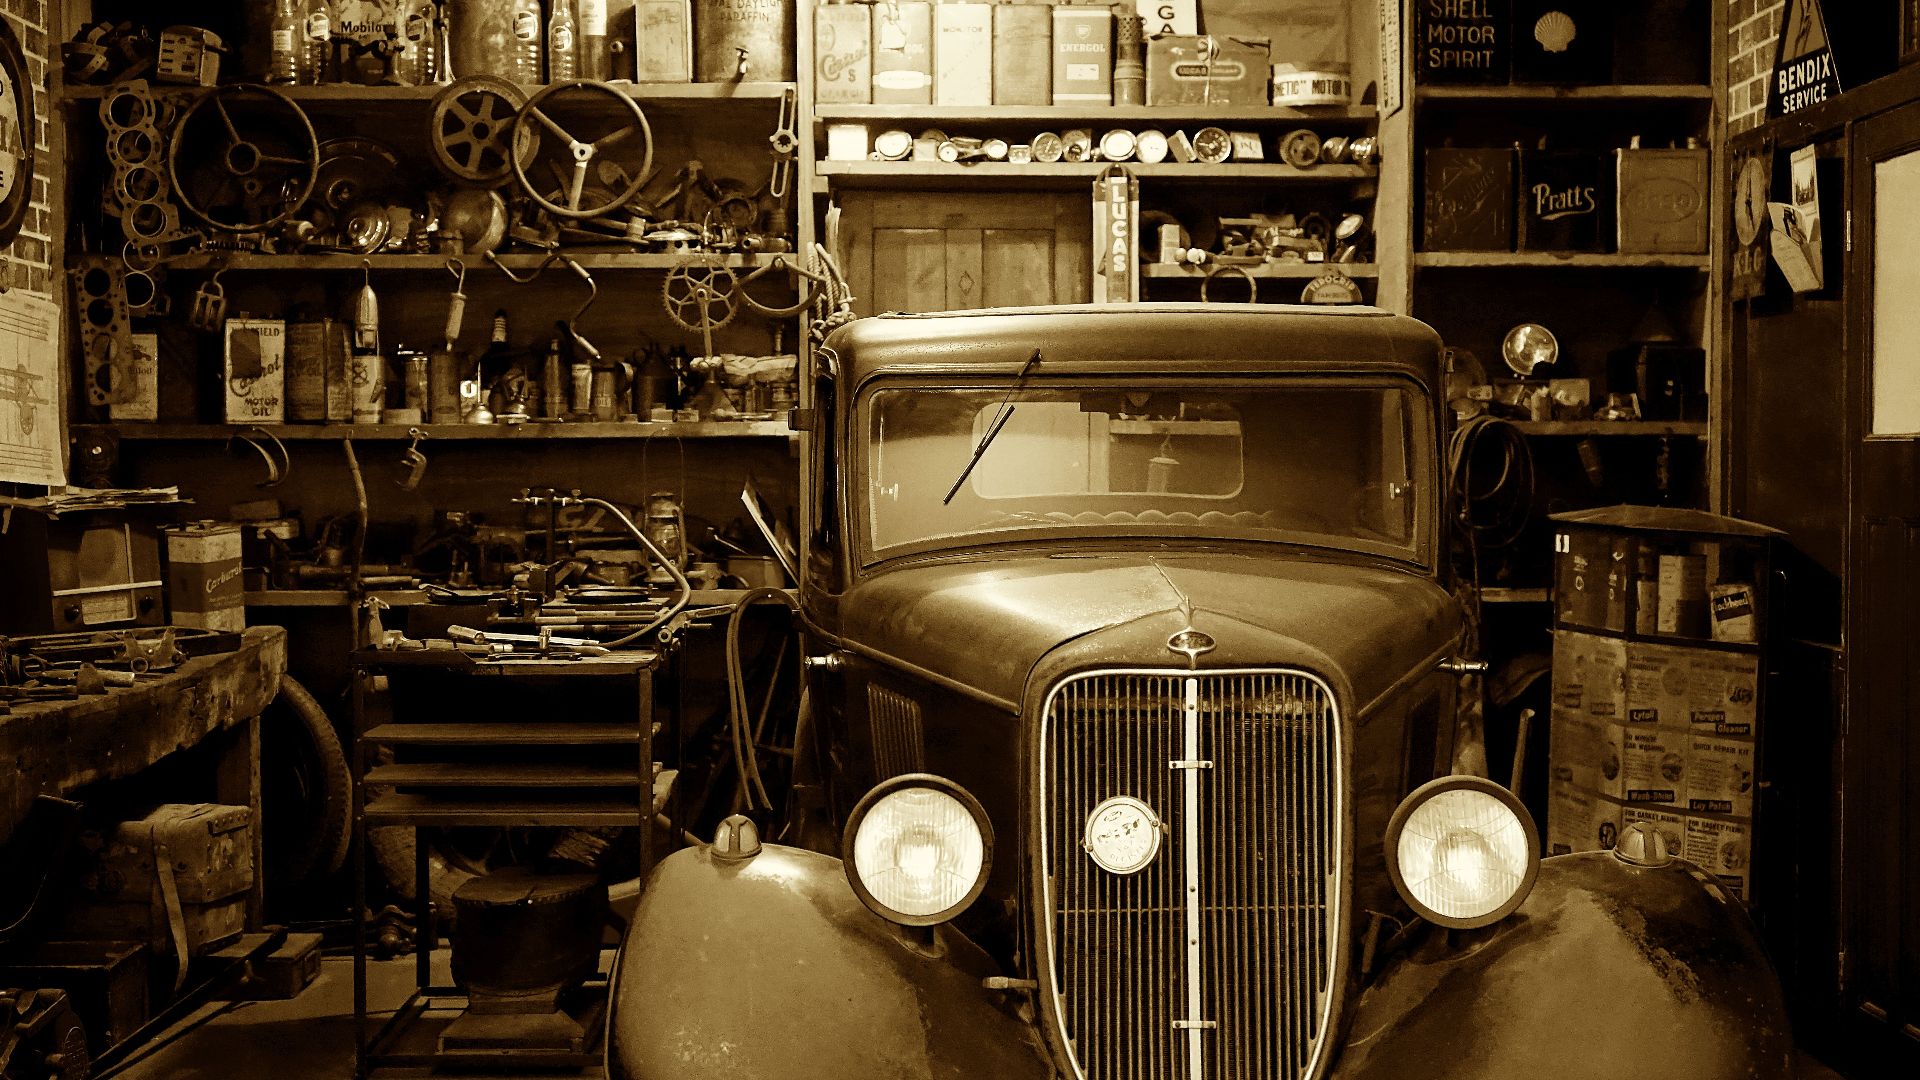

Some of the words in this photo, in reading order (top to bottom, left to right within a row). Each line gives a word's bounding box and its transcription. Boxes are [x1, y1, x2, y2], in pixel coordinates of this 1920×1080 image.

[721, 11, 769, 22] PARAFFIN
[1430, 0, 1493, 18] SHELL
[1157, 0, 1176, 35] GA
[341, 21, 395, 32] Mobilo
[1428, 24, 1495, 44] MOTOR
[1060, 43, 1105, 53] ENERGOL
[1429, 48, 1494, 68] SPIRIT
[848, 68, 857, 83] S
[1779, 52, 1831, 95] BENDIX
[1312, 79, 1342, 95] MOTOR
[1782, 82, 1827, 114] SERVICE
[1532, 183, 1595, 220] Pratts
[1111, 185, 1128, 272] LUCAS
[245, 397, 278, 406] MOTOR
[252, 407, 271, 417] OIL
[1625, 809, 1636, 817] FOR
[1688, 819, 1700, 828] FOR
